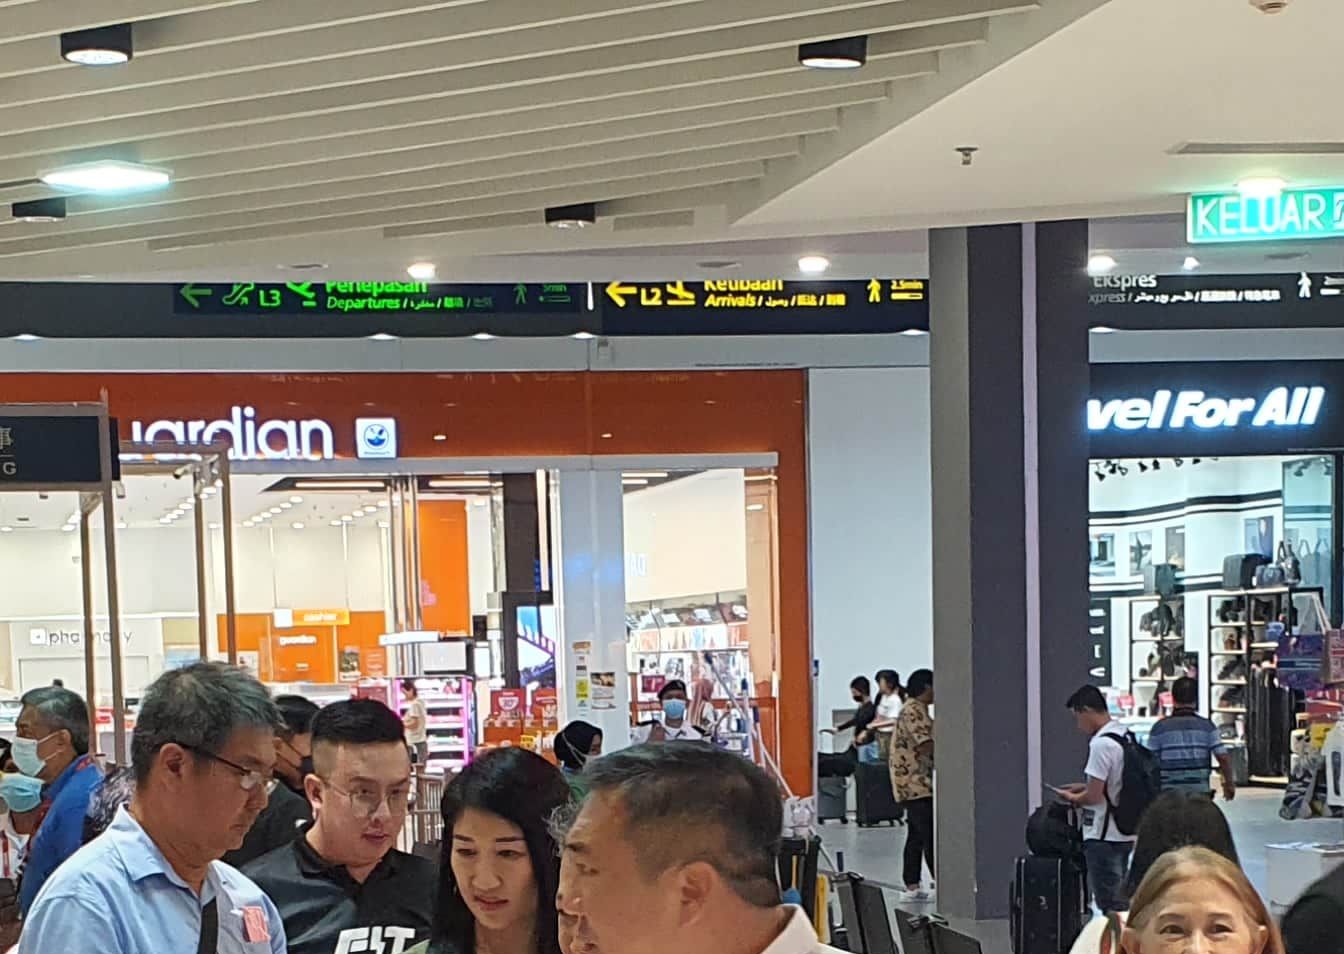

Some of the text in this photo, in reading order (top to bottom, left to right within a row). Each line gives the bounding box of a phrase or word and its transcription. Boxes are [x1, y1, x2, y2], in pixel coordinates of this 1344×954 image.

[1197, 193, 1327, 236] KELUAR
[259, 289, 282, 307] L3
[326, 295, 401, 311] Departures
[640, 287, 663, 306] L2
[704, 293, 757, 308] Arrivals
[1170, 390, 1255, 428] For
[1253, 386, 1326, 427] All
